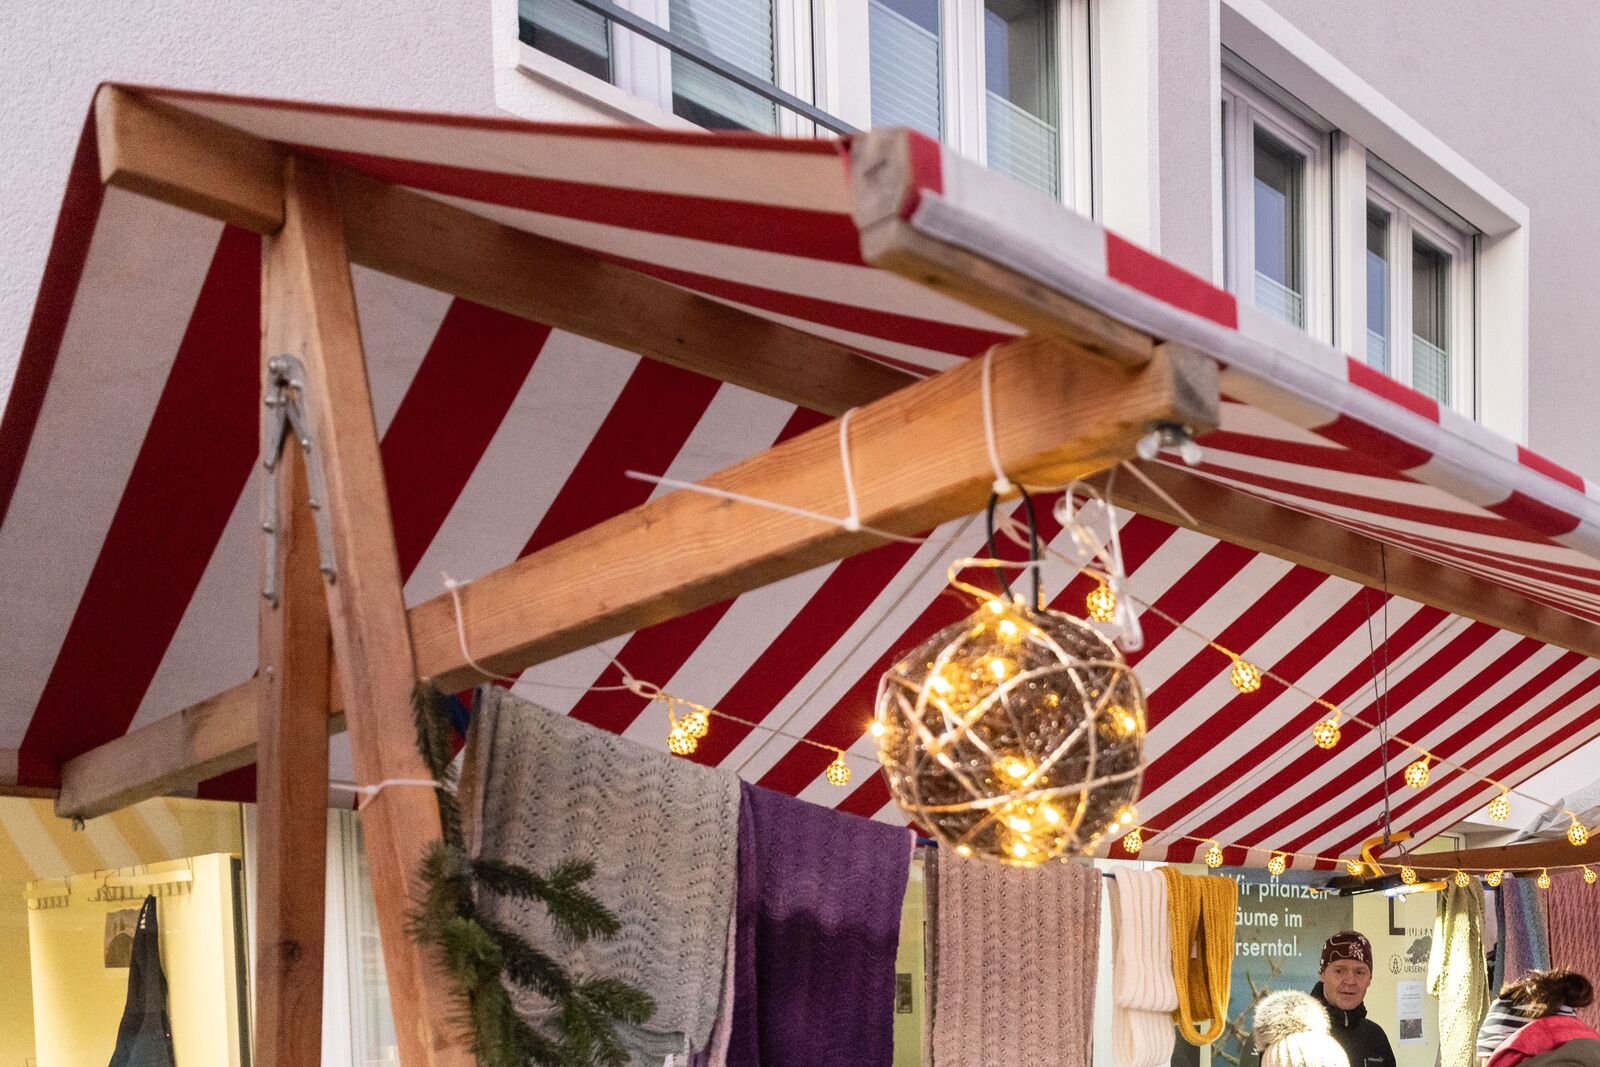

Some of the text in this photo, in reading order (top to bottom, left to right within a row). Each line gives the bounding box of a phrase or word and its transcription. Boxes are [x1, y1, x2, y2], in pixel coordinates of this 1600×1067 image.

[1235, 907, 1303, 927] äume im
[1235, 935, 1302, 957] rserntal.
[1404, 965, 1426, 974] URSERN
